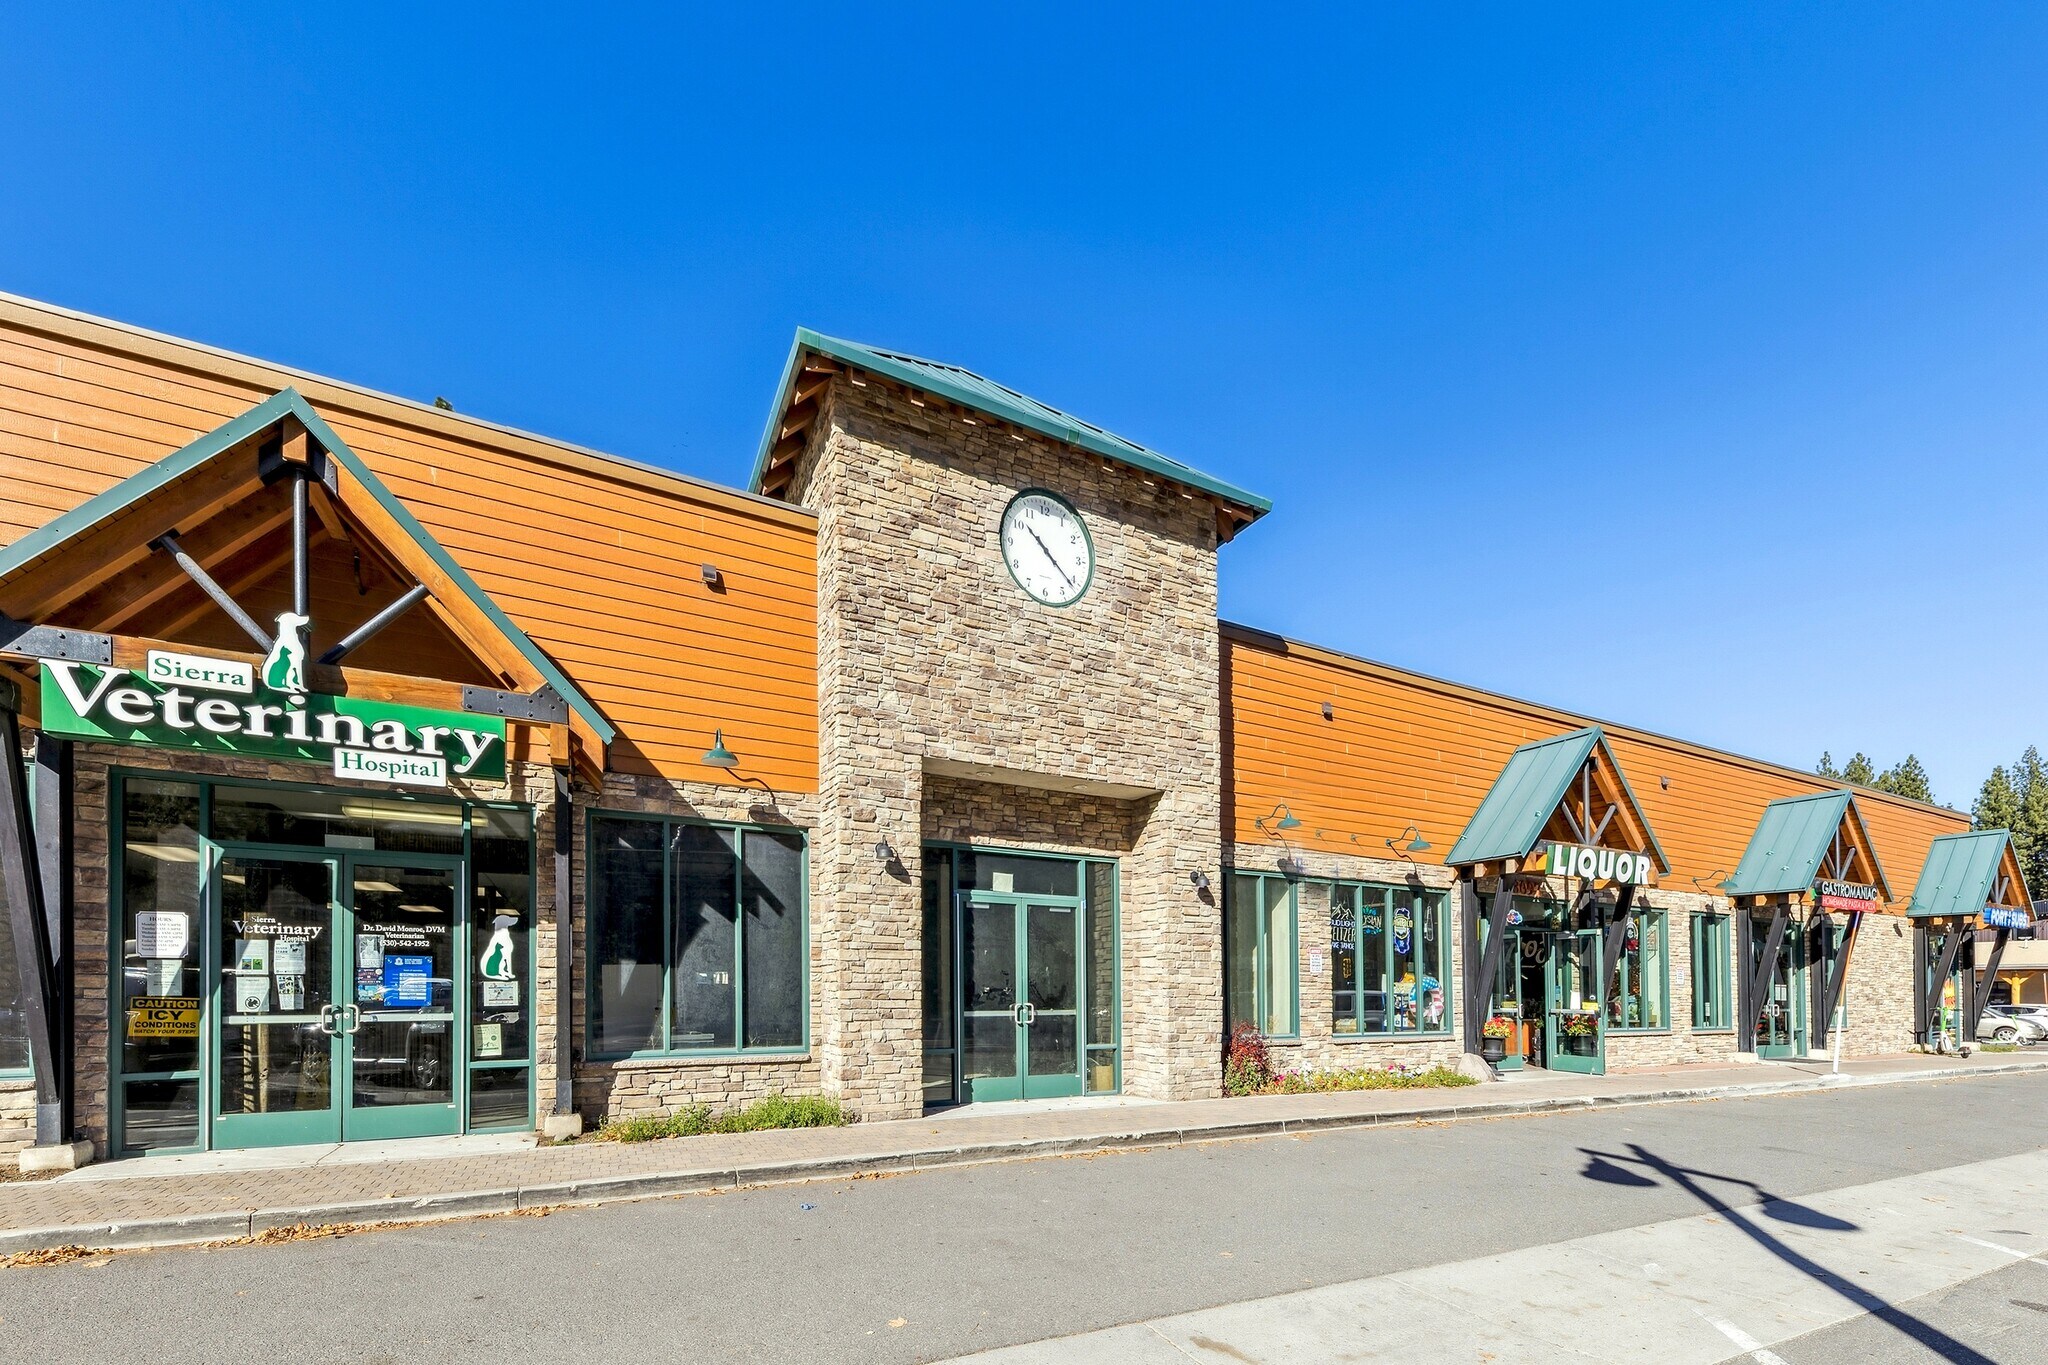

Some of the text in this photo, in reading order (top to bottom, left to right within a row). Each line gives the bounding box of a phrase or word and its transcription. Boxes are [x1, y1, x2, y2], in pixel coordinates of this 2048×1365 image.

[1025, 508, 1034, 520] 11
[1040, 505, 1050, 517] 12
[1013, 518, 1025, 530] 10
[1007, 537, 1014, 547] 9
[1070, 535, 1076, 545] 2
[1013, 559, 1019, 569] 8
[1076, 556, 1081, 566] 3
[1026, 577, 1032, 588] 7
[1042, 587, 1049, 597] 6
[154, 657, 247, 686] Sierra
[38, 657, 499, 774] Veterinary
[341, 751, 440, 780] Hospital
[1552, 844, 1651, 885] LIQUOR
[1822, 881, 1877, 901] GASTROMANIAC
[232, 920, 322, 939] Veterinary
[376, 924, 396, 932] David
[397, 925, 425, 933] Monroe,
[380, 939, 430, 947] (530)-542-1952
[135, 1000, 198, 1008] CAUTION
[147, 1010, 184, 1020] ICY
[134, 1021, 197, 1029] CONDITIONS
